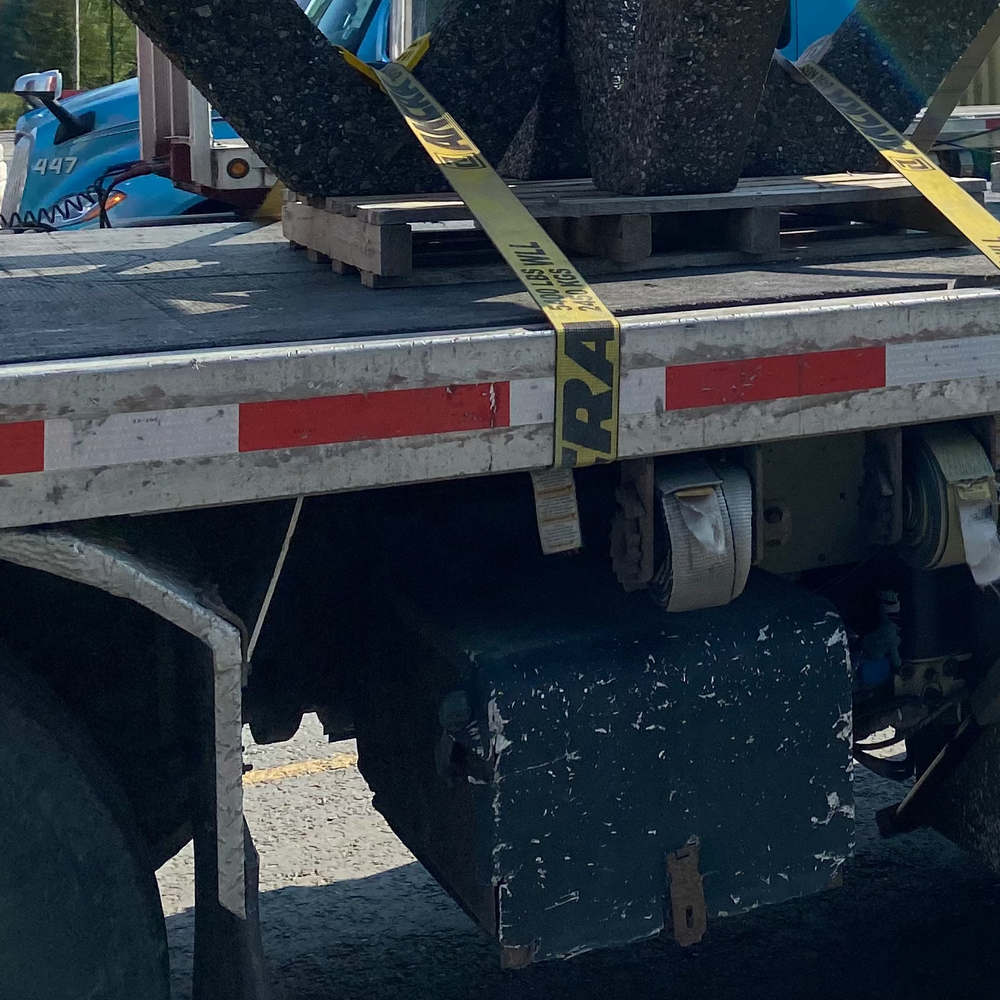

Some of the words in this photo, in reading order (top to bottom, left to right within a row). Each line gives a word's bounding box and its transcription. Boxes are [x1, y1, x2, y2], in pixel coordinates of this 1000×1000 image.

[389, 77, 473, 150] ANCRA
[34, 157, 77, 175] 447
[509, 241, 555, 266] WLL
[521, 268, 554, 287] LBS
[549, 268, 582, 287] KGS
[535, 288, 573, 311] 5400
[565, 289, 602, 312] 2450
